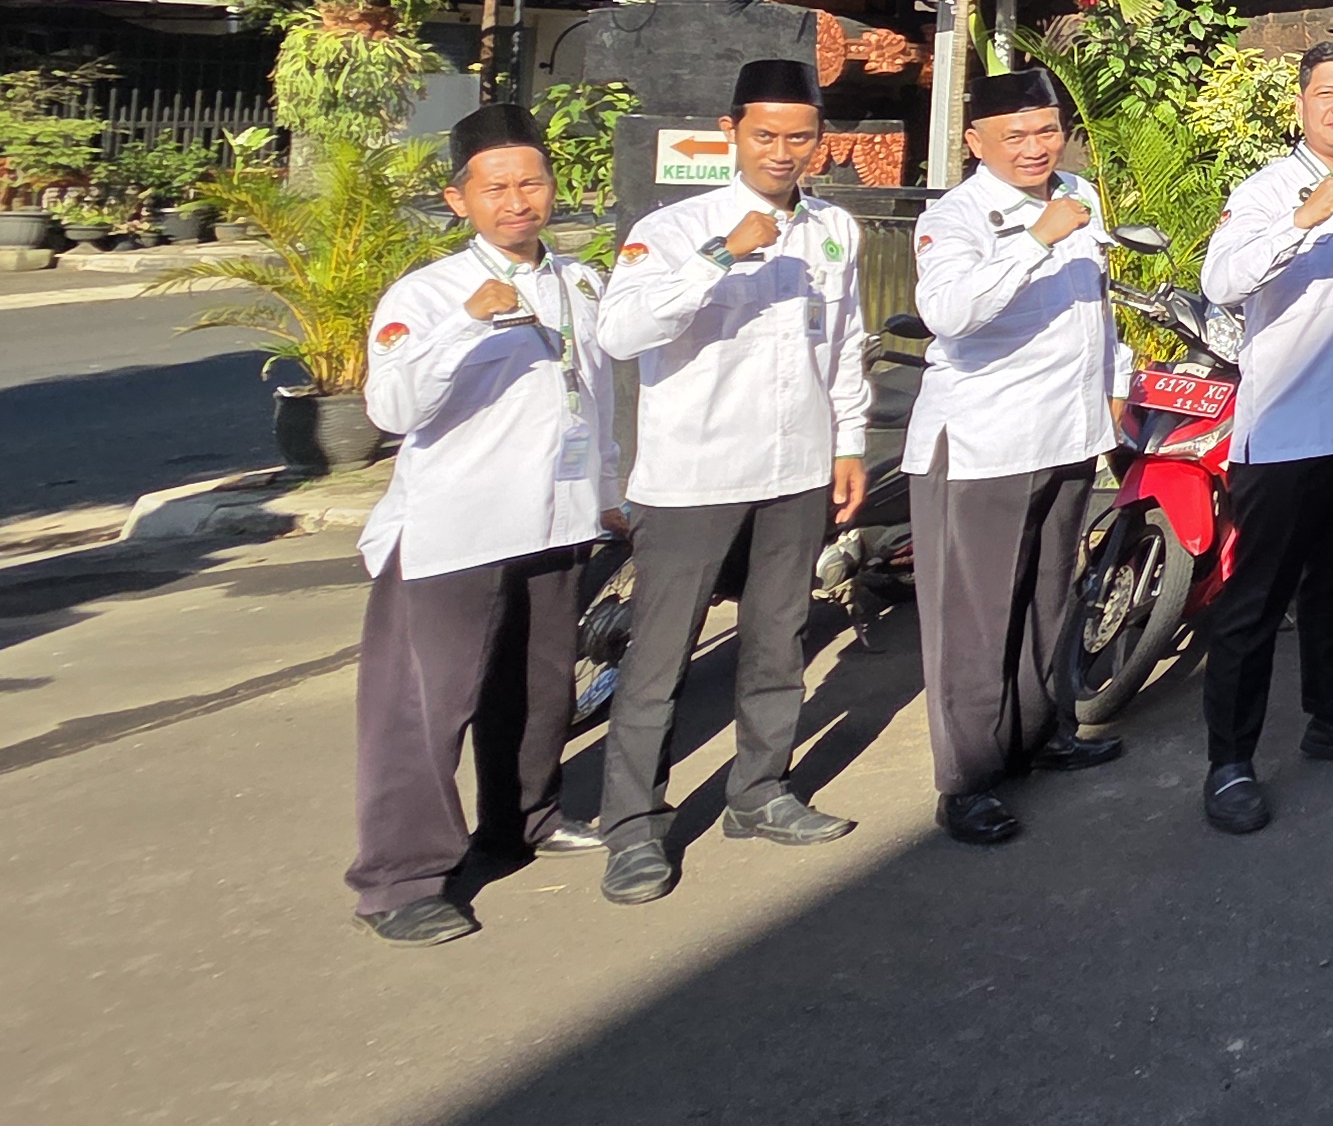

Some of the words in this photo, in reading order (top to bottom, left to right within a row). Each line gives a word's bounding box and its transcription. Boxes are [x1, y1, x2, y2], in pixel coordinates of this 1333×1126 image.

[663, 165, 731, 180] KELUAR
[1132, 373, 1148, 388] R
[1155, 377, 1197, 395] 6179
[1203, 384, 1228, 400] XC
